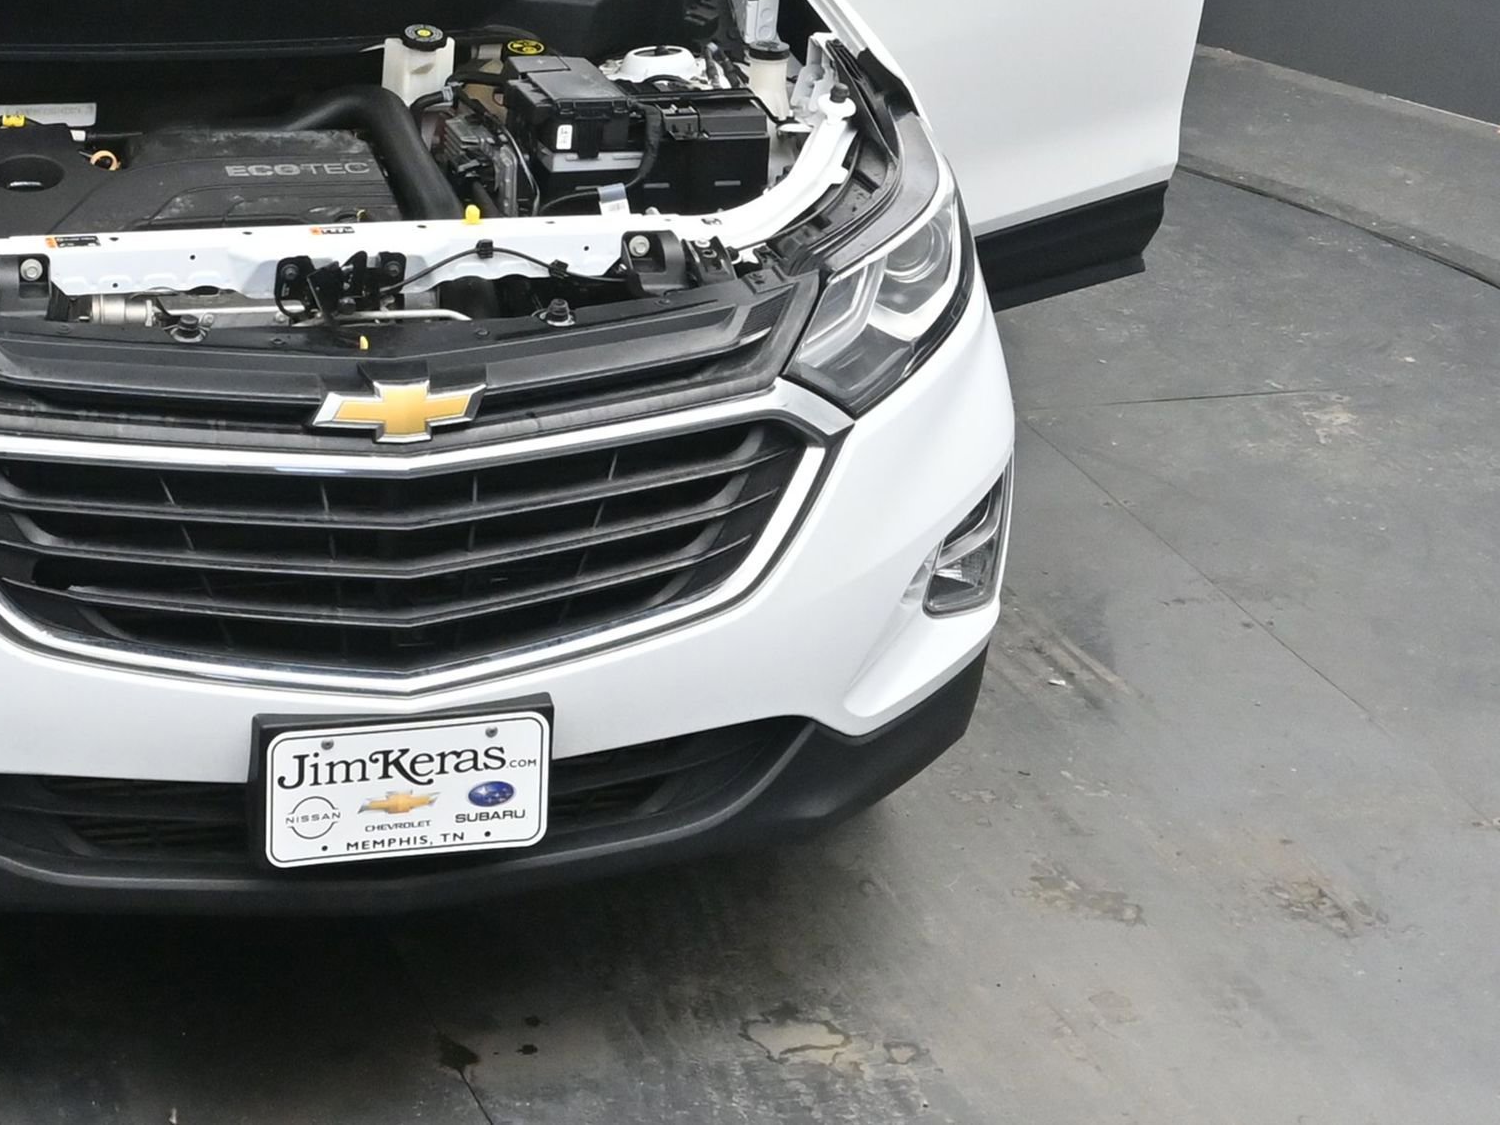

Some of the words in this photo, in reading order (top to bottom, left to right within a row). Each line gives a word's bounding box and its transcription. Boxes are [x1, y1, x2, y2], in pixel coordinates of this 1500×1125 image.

[225, 162, 370, 177] ECOTEC
[285, 808, 341, 824] NISSAN
[455, 809, 527, 823] SUBARU
[364, 819, 432, 833] CHEVROLET
[346, 835, 433, 851] MEMPHIS,
[440, 831, 465, 842] TN
